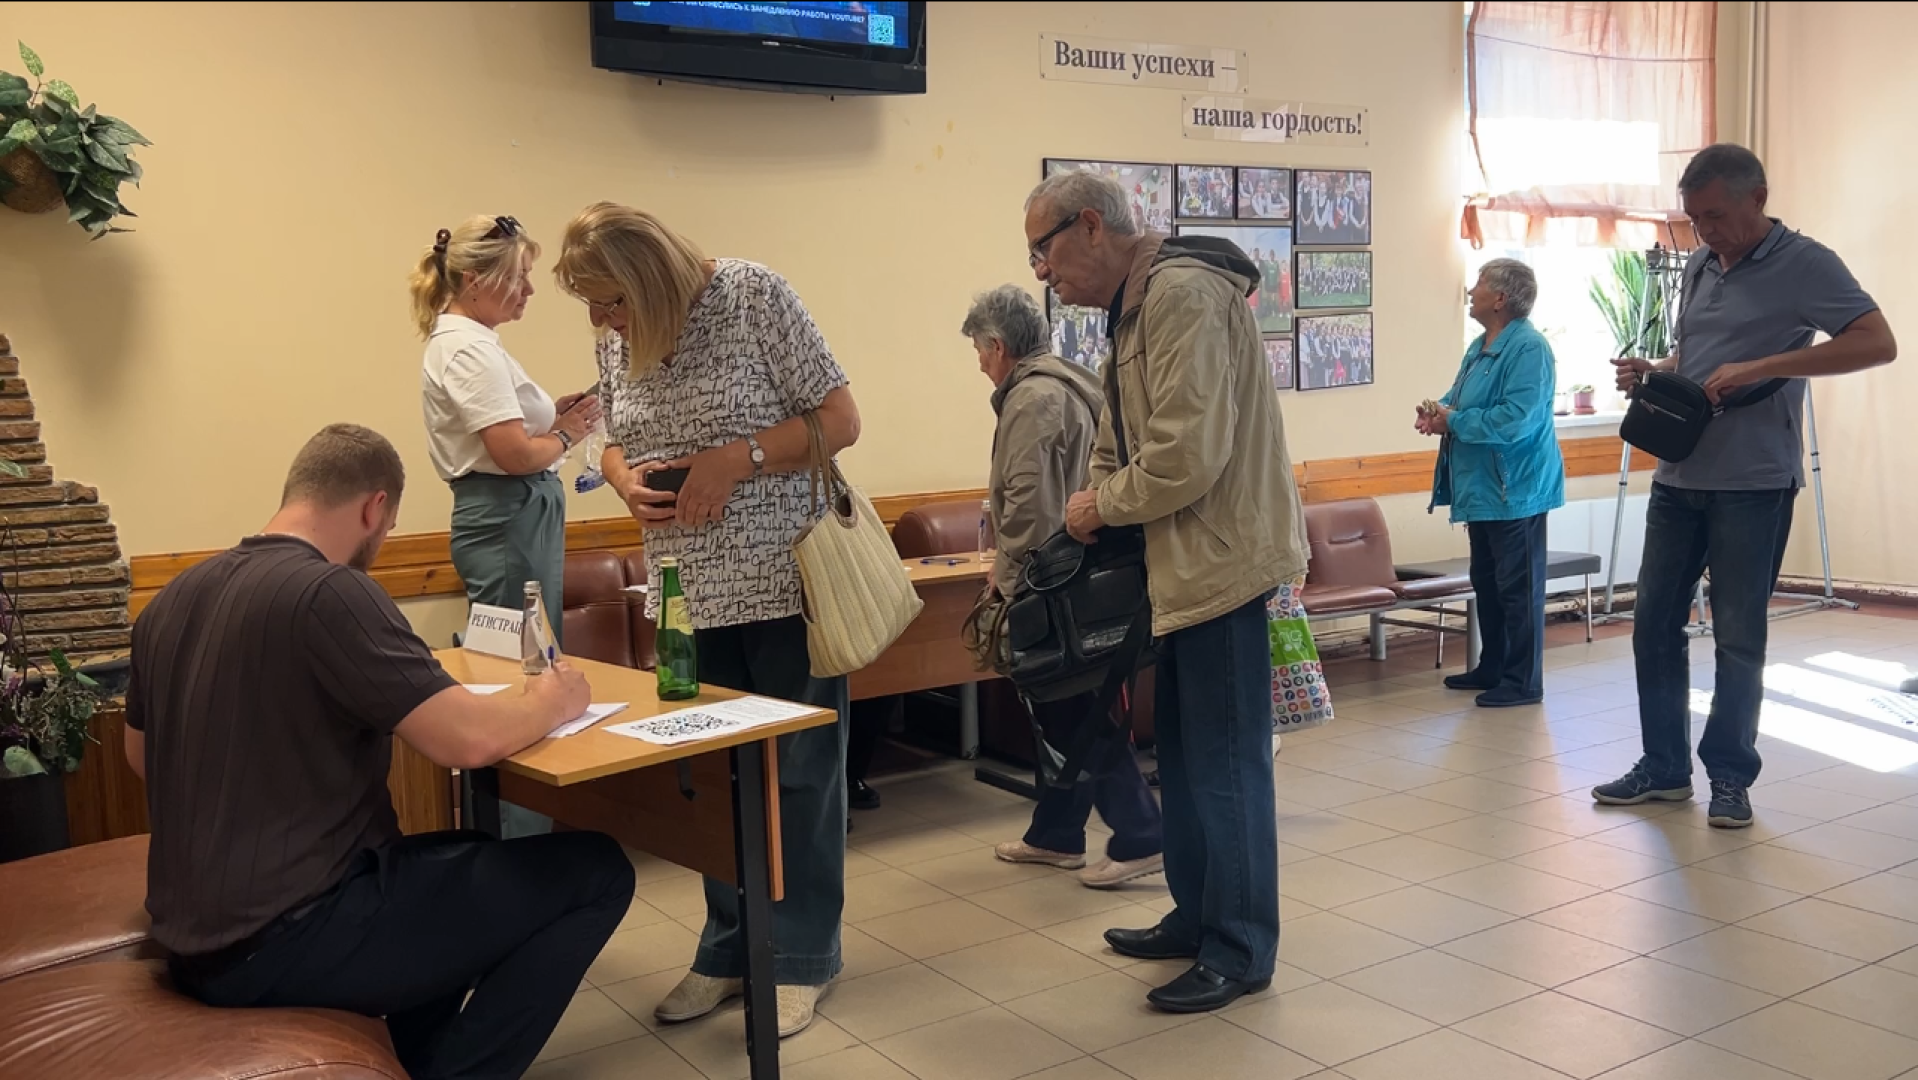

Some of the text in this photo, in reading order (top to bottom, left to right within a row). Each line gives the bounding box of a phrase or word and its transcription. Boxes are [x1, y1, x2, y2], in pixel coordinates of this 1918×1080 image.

[801, 10, 830, 19] РАБОТЫ
[1054, 40, 1127, 71] Ваши
[1131, 52, 1215, 80] успехи
[1192, 106, 1362, 138] наша гордость!
